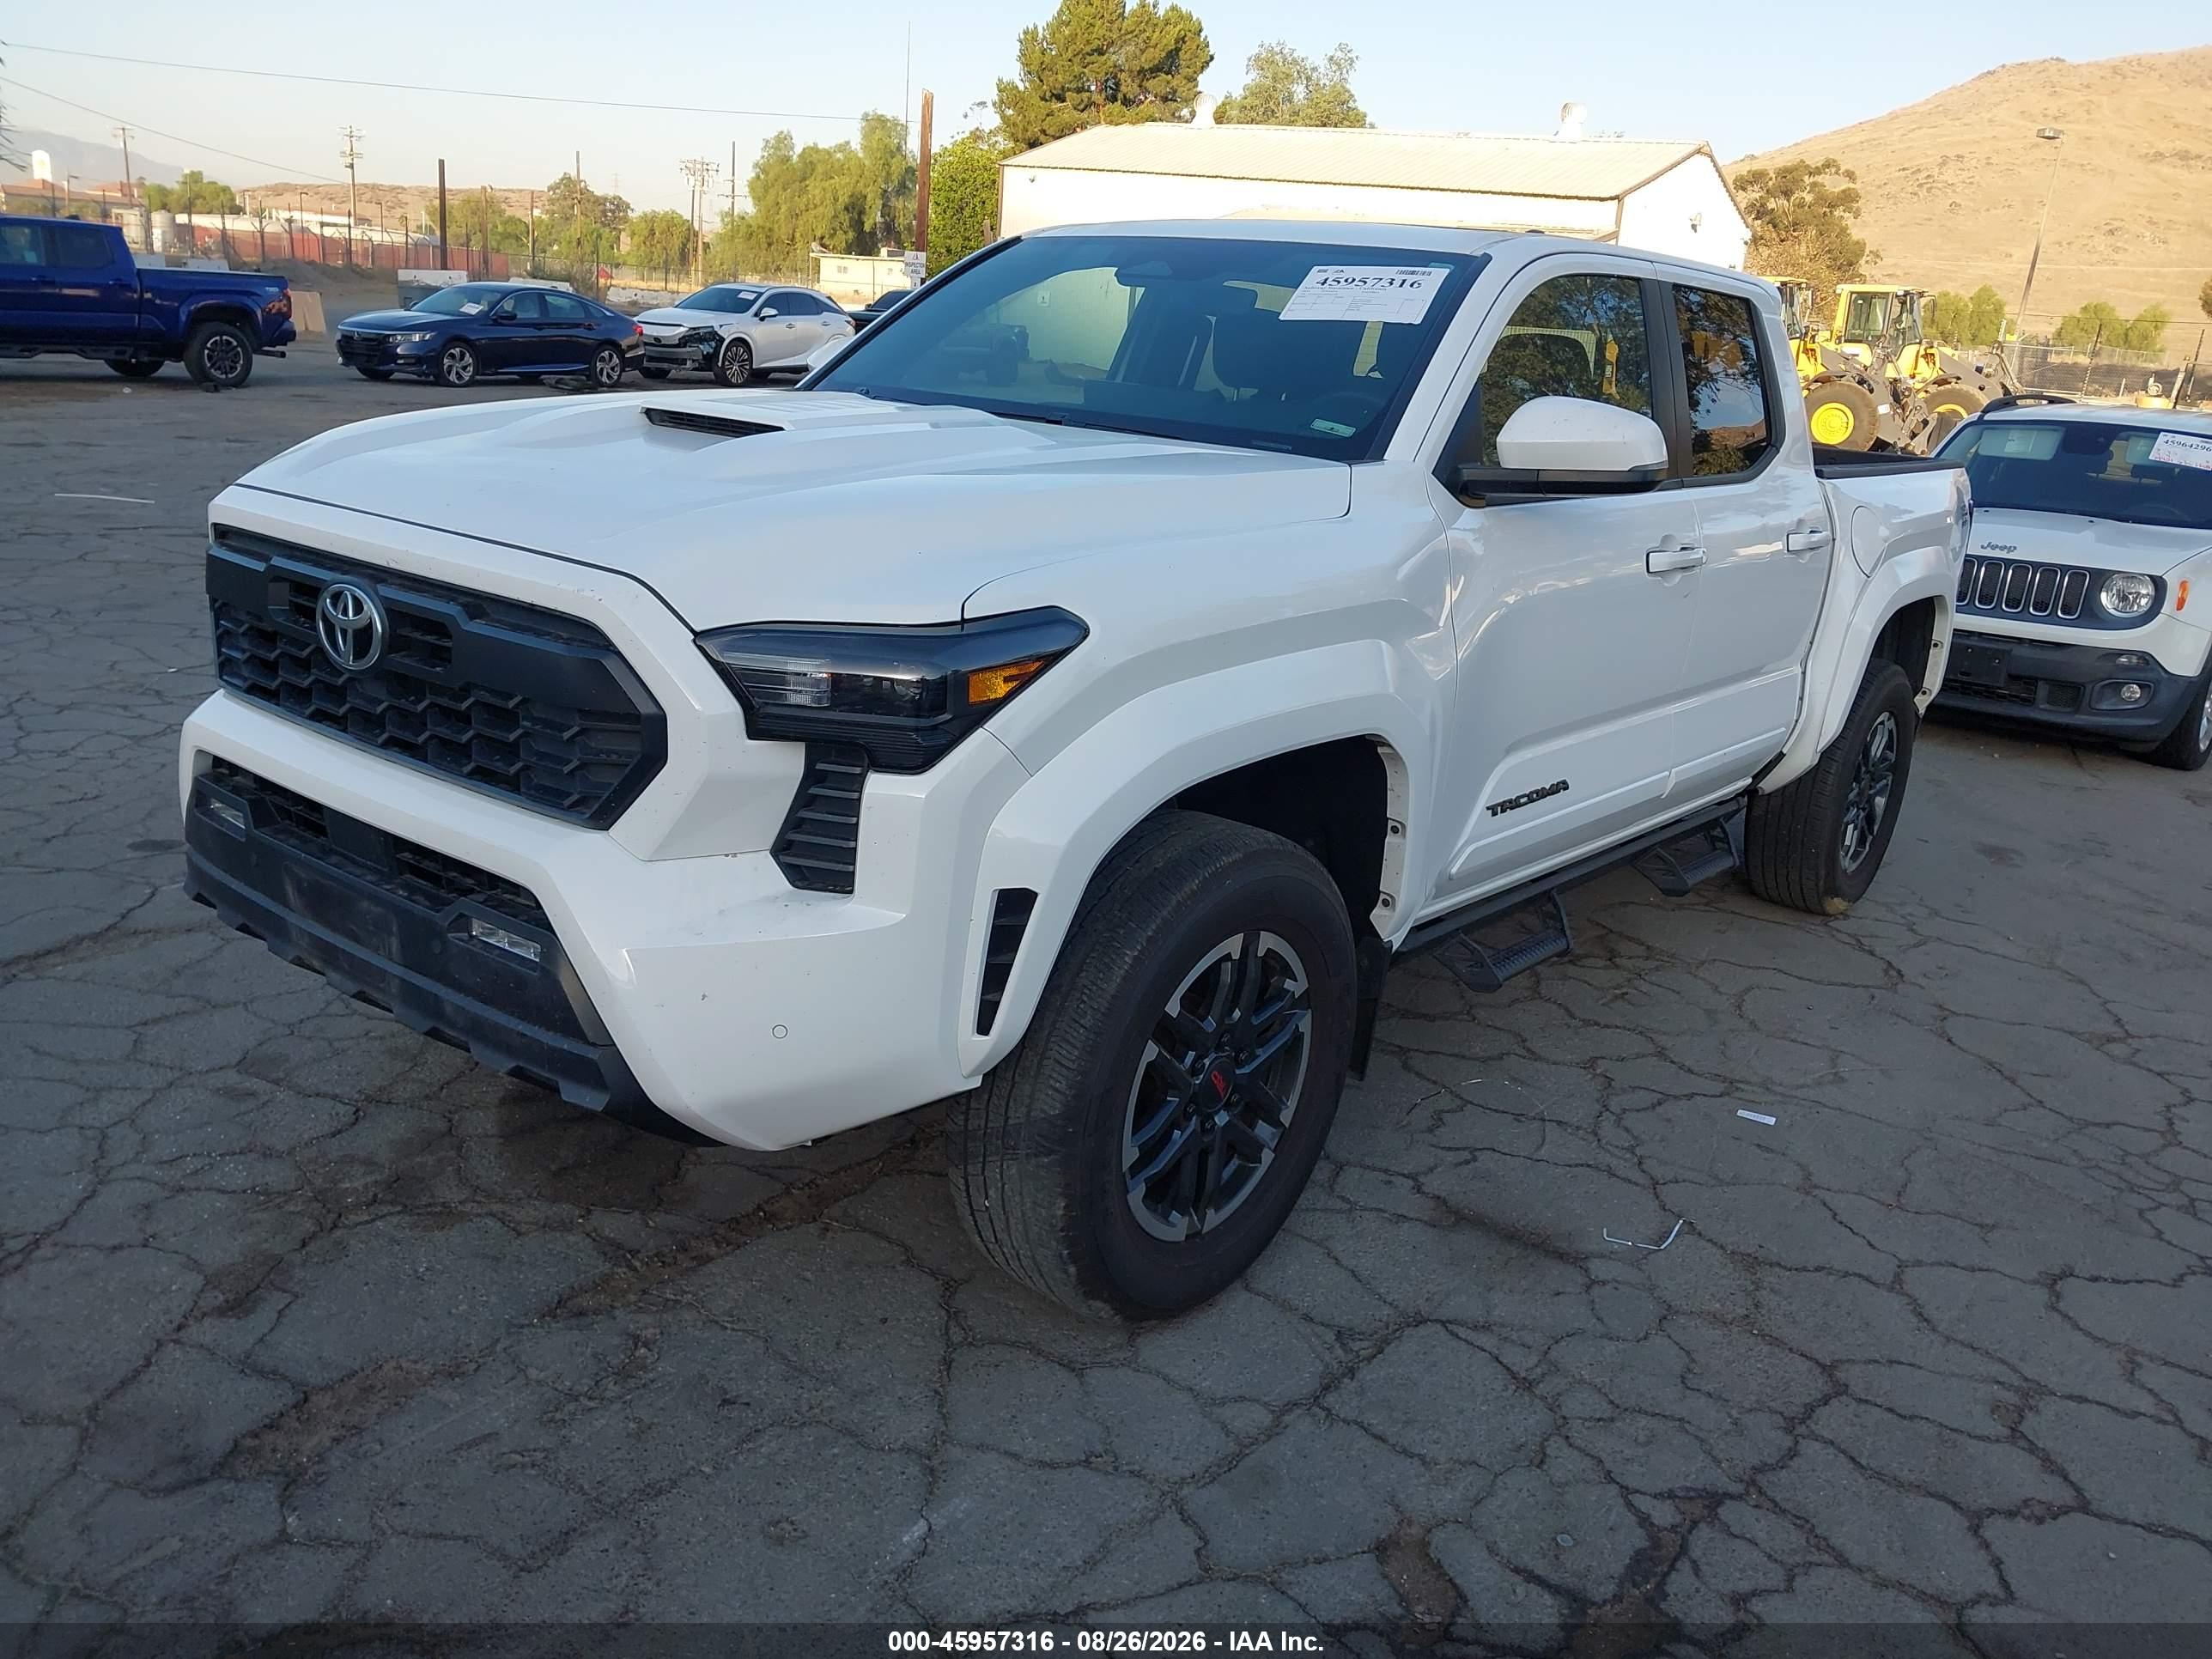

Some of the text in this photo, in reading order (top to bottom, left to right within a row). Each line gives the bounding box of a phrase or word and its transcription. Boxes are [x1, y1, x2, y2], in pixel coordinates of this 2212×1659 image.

[1316, 276, 1425, 289] 45957316
[2163, 439, 2212, 453] 45964296
[1980, 541, 2017, 554] Jeep
[1485, 778, 1570, 817] TACOMA
